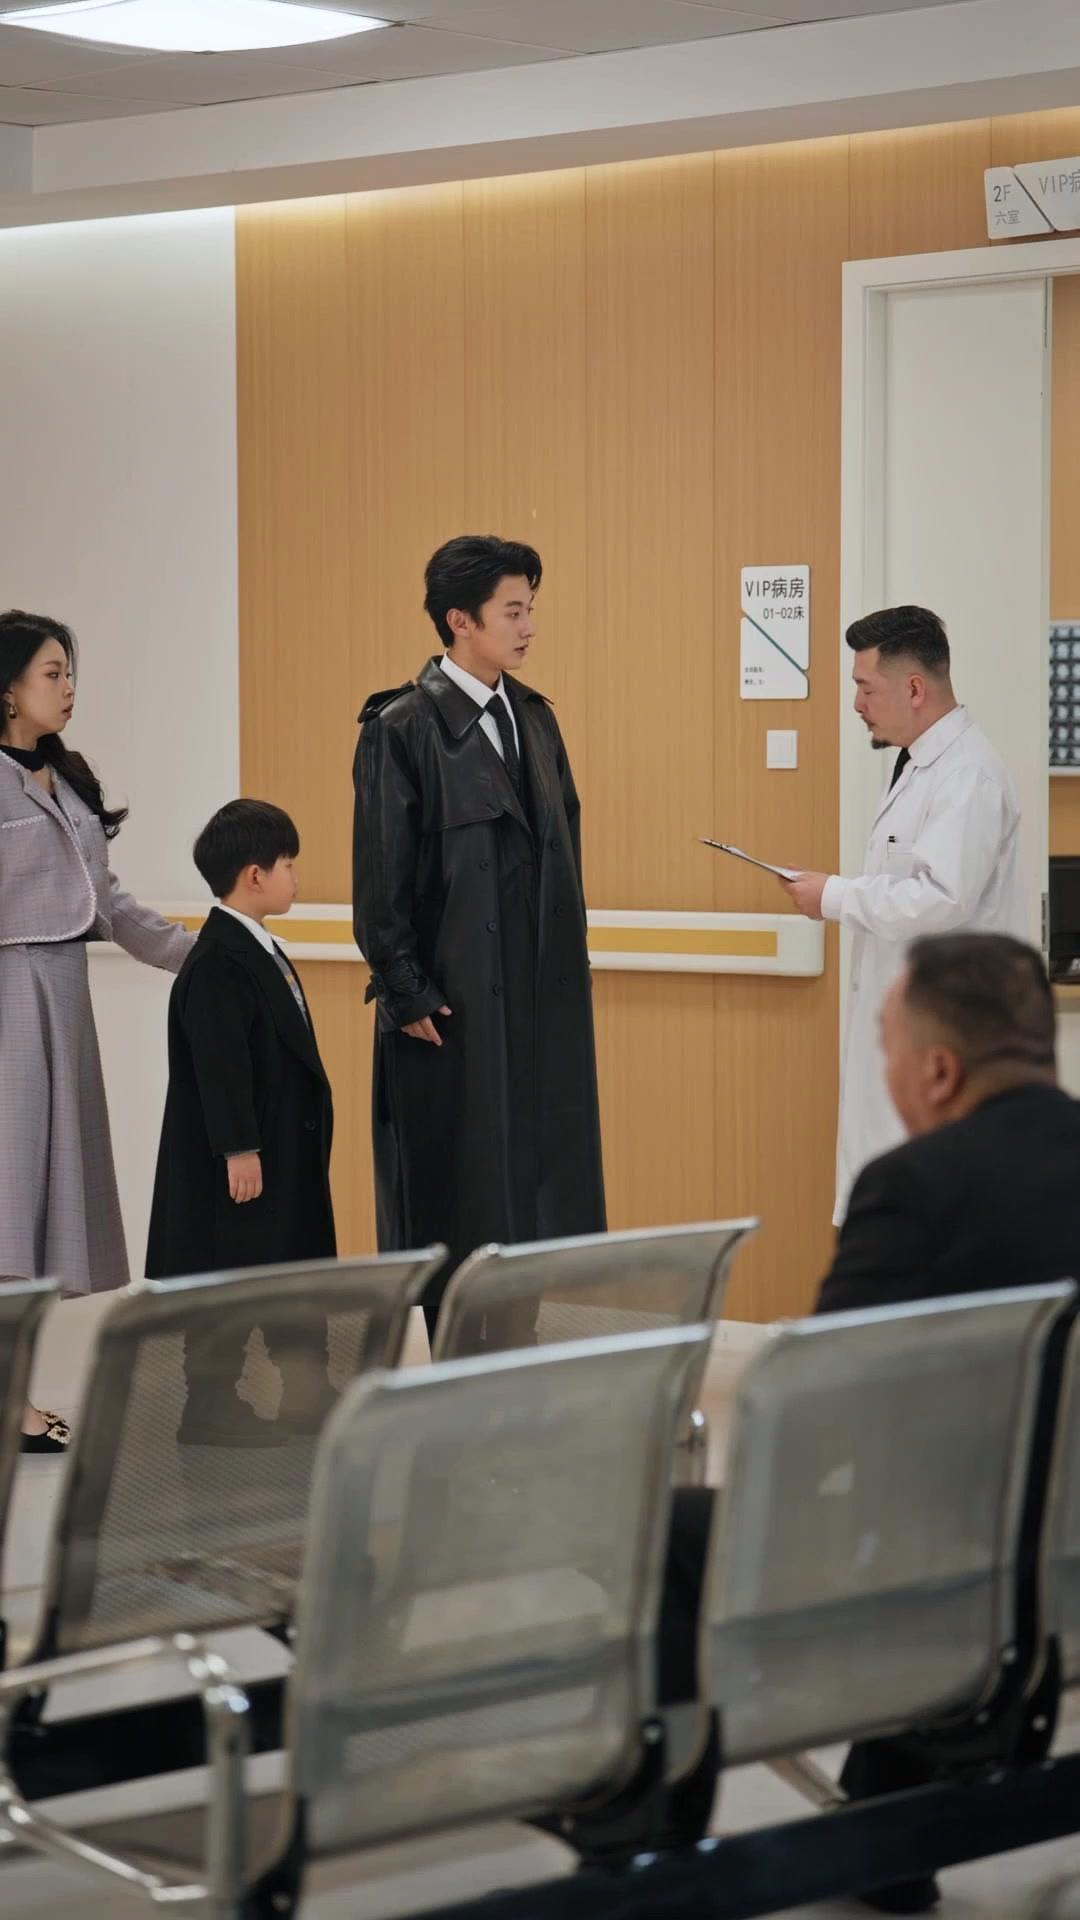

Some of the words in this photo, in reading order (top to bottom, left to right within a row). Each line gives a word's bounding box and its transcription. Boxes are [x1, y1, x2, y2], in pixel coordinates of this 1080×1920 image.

[993, 184, 1012, 202] 2F
[745, 577, 805, 598] VIP病房
[763, 605, 805, 621] 01-02床
